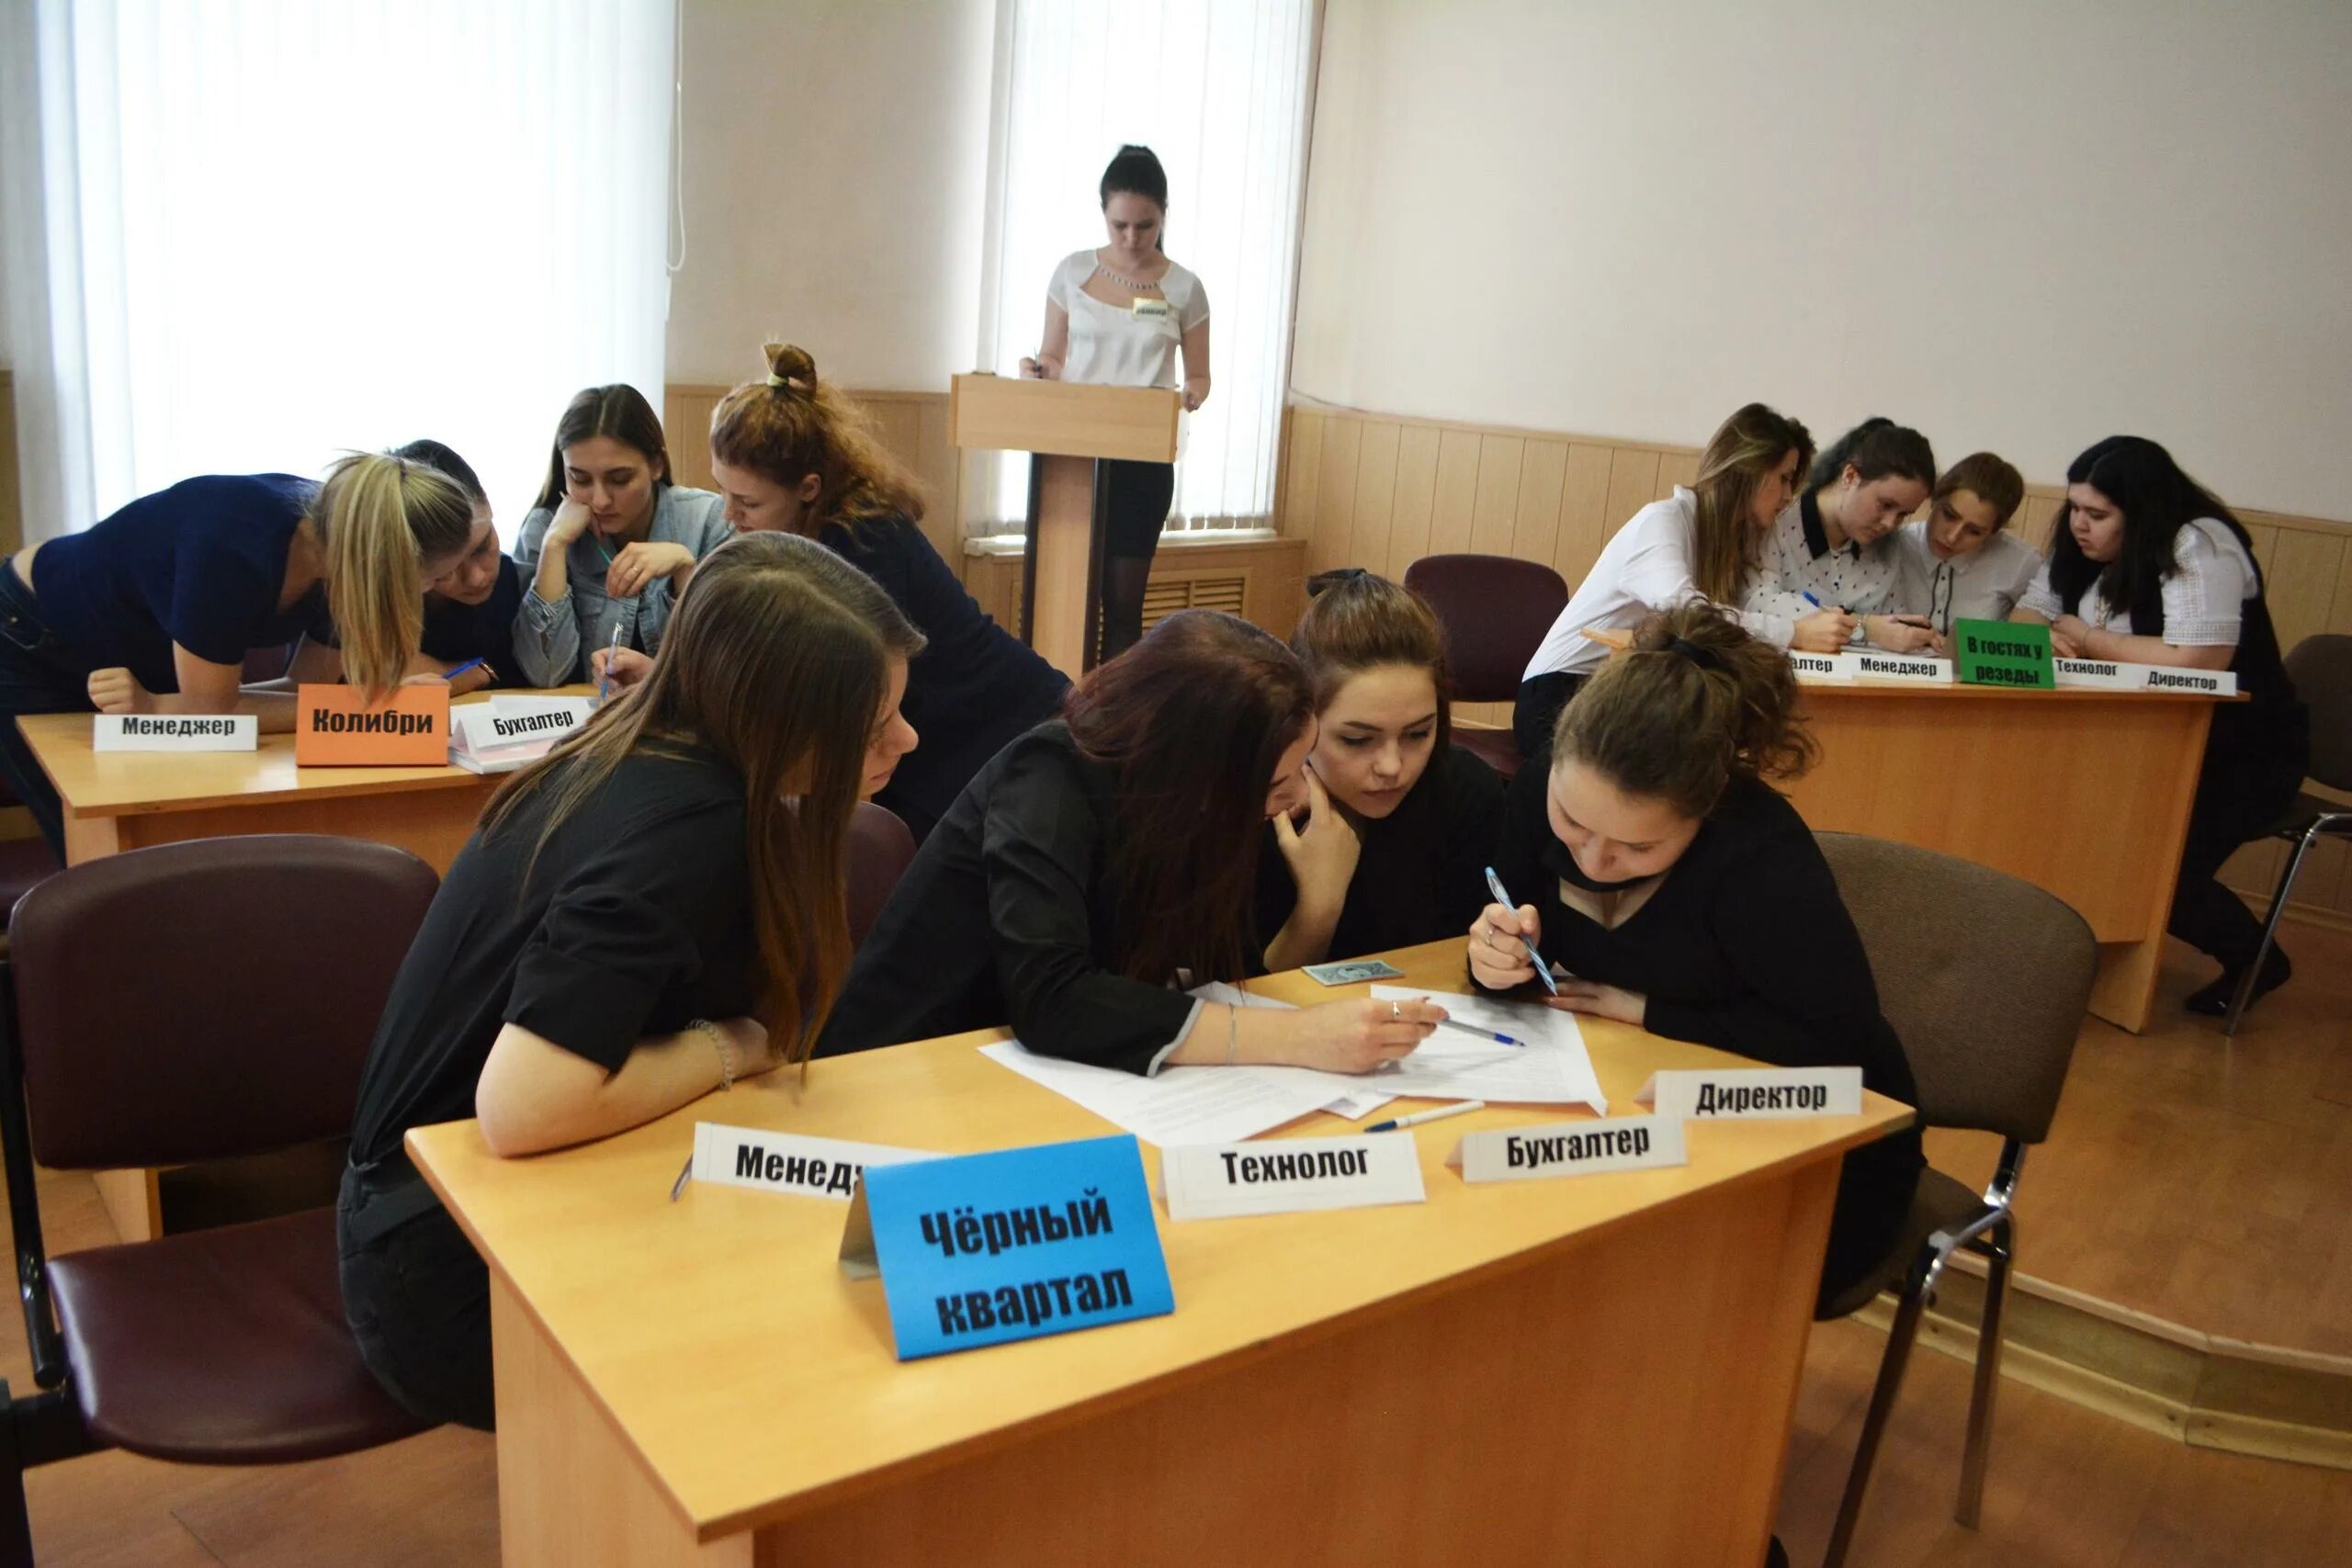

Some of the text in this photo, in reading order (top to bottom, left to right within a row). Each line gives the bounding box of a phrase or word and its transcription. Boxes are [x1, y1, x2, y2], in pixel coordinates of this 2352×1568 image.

[1967, 636, 2043, 660] В гостях у
[1791, 657, 1834, 672] алтер
[1860, 658, 1937, 677] Менеджер
[1975, 665, 2040, 684] резеды
[2056, 660, 2117, 676] Технолог
[2148, 671, 2218, 690] Директор
[122, 717, 235, 737] Менеджер
[312, 709, 433, 736] Колибри
[493, 710, 574, 736] Бухгалтер
[1696, 1083, 1827, 1115] Директор
[1507, 1126, 1650, 1168] Бухгалтер
[736, 1145, 863, 1196] Менед
[1220, 1148, 1368, 1185] Технолог
[920, 1186, 1114, 1258] Чёрный
[935, 1268, 1134, 1337] квартал
